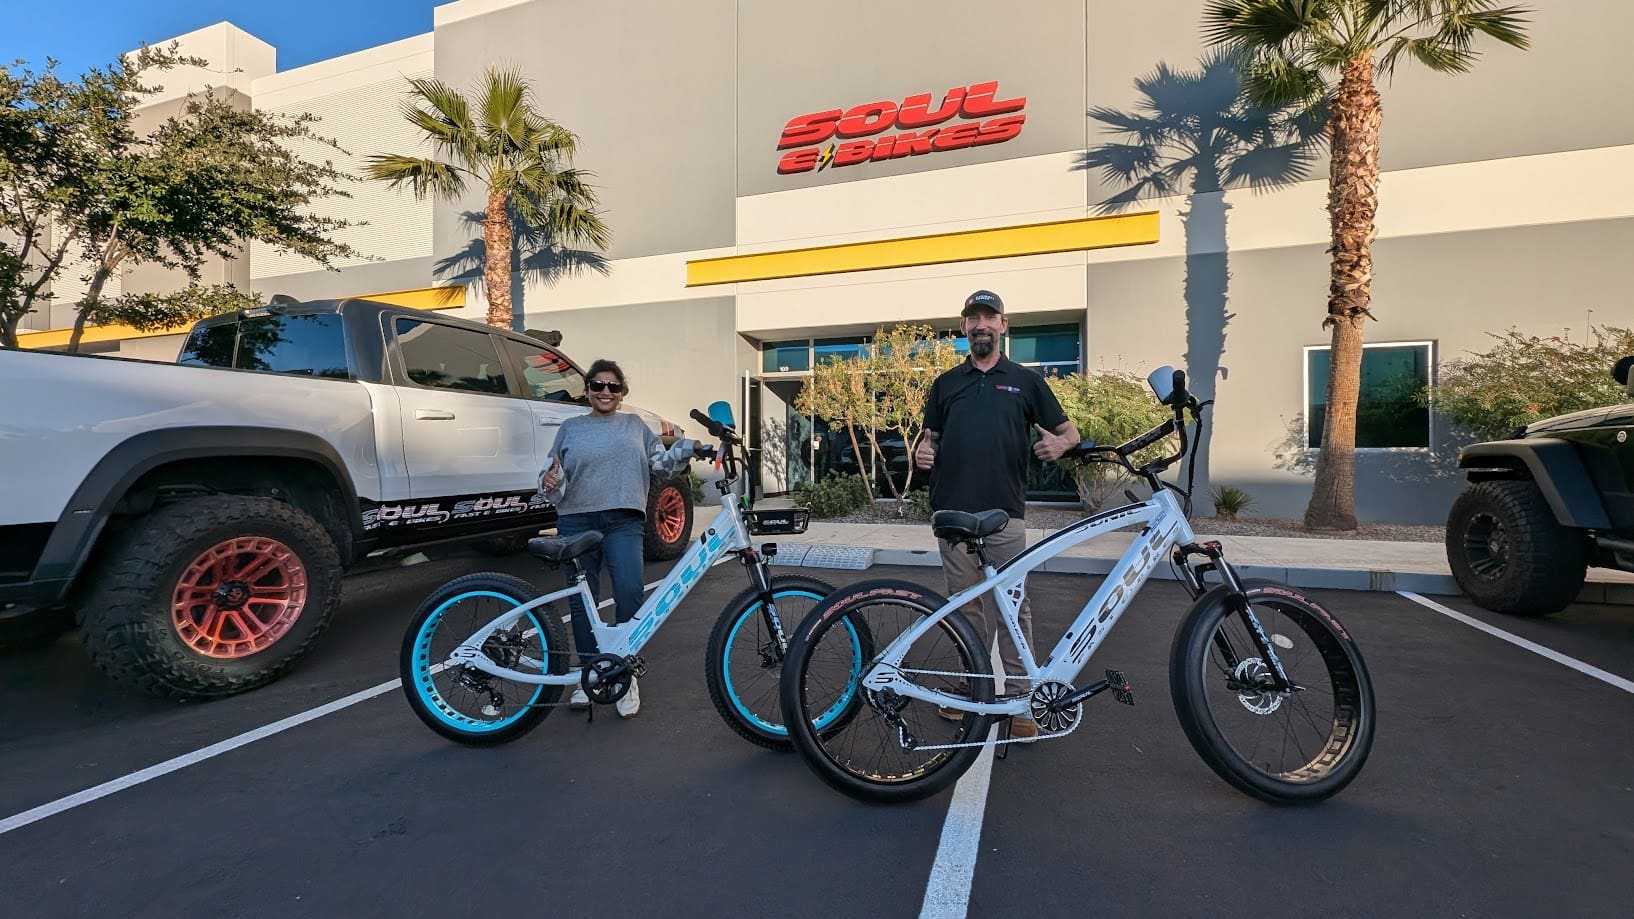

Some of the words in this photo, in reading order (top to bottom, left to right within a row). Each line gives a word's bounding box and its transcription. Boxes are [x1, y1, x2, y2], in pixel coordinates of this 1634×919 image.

[777, 81, 1027, 150] SOUL
[362, 503, 450, 526] SOUL
[451, 496, 528, 514] SOUL
[628, 525, 736, 652] SOUL
[1069, 520, 1178, 664] SOUL
